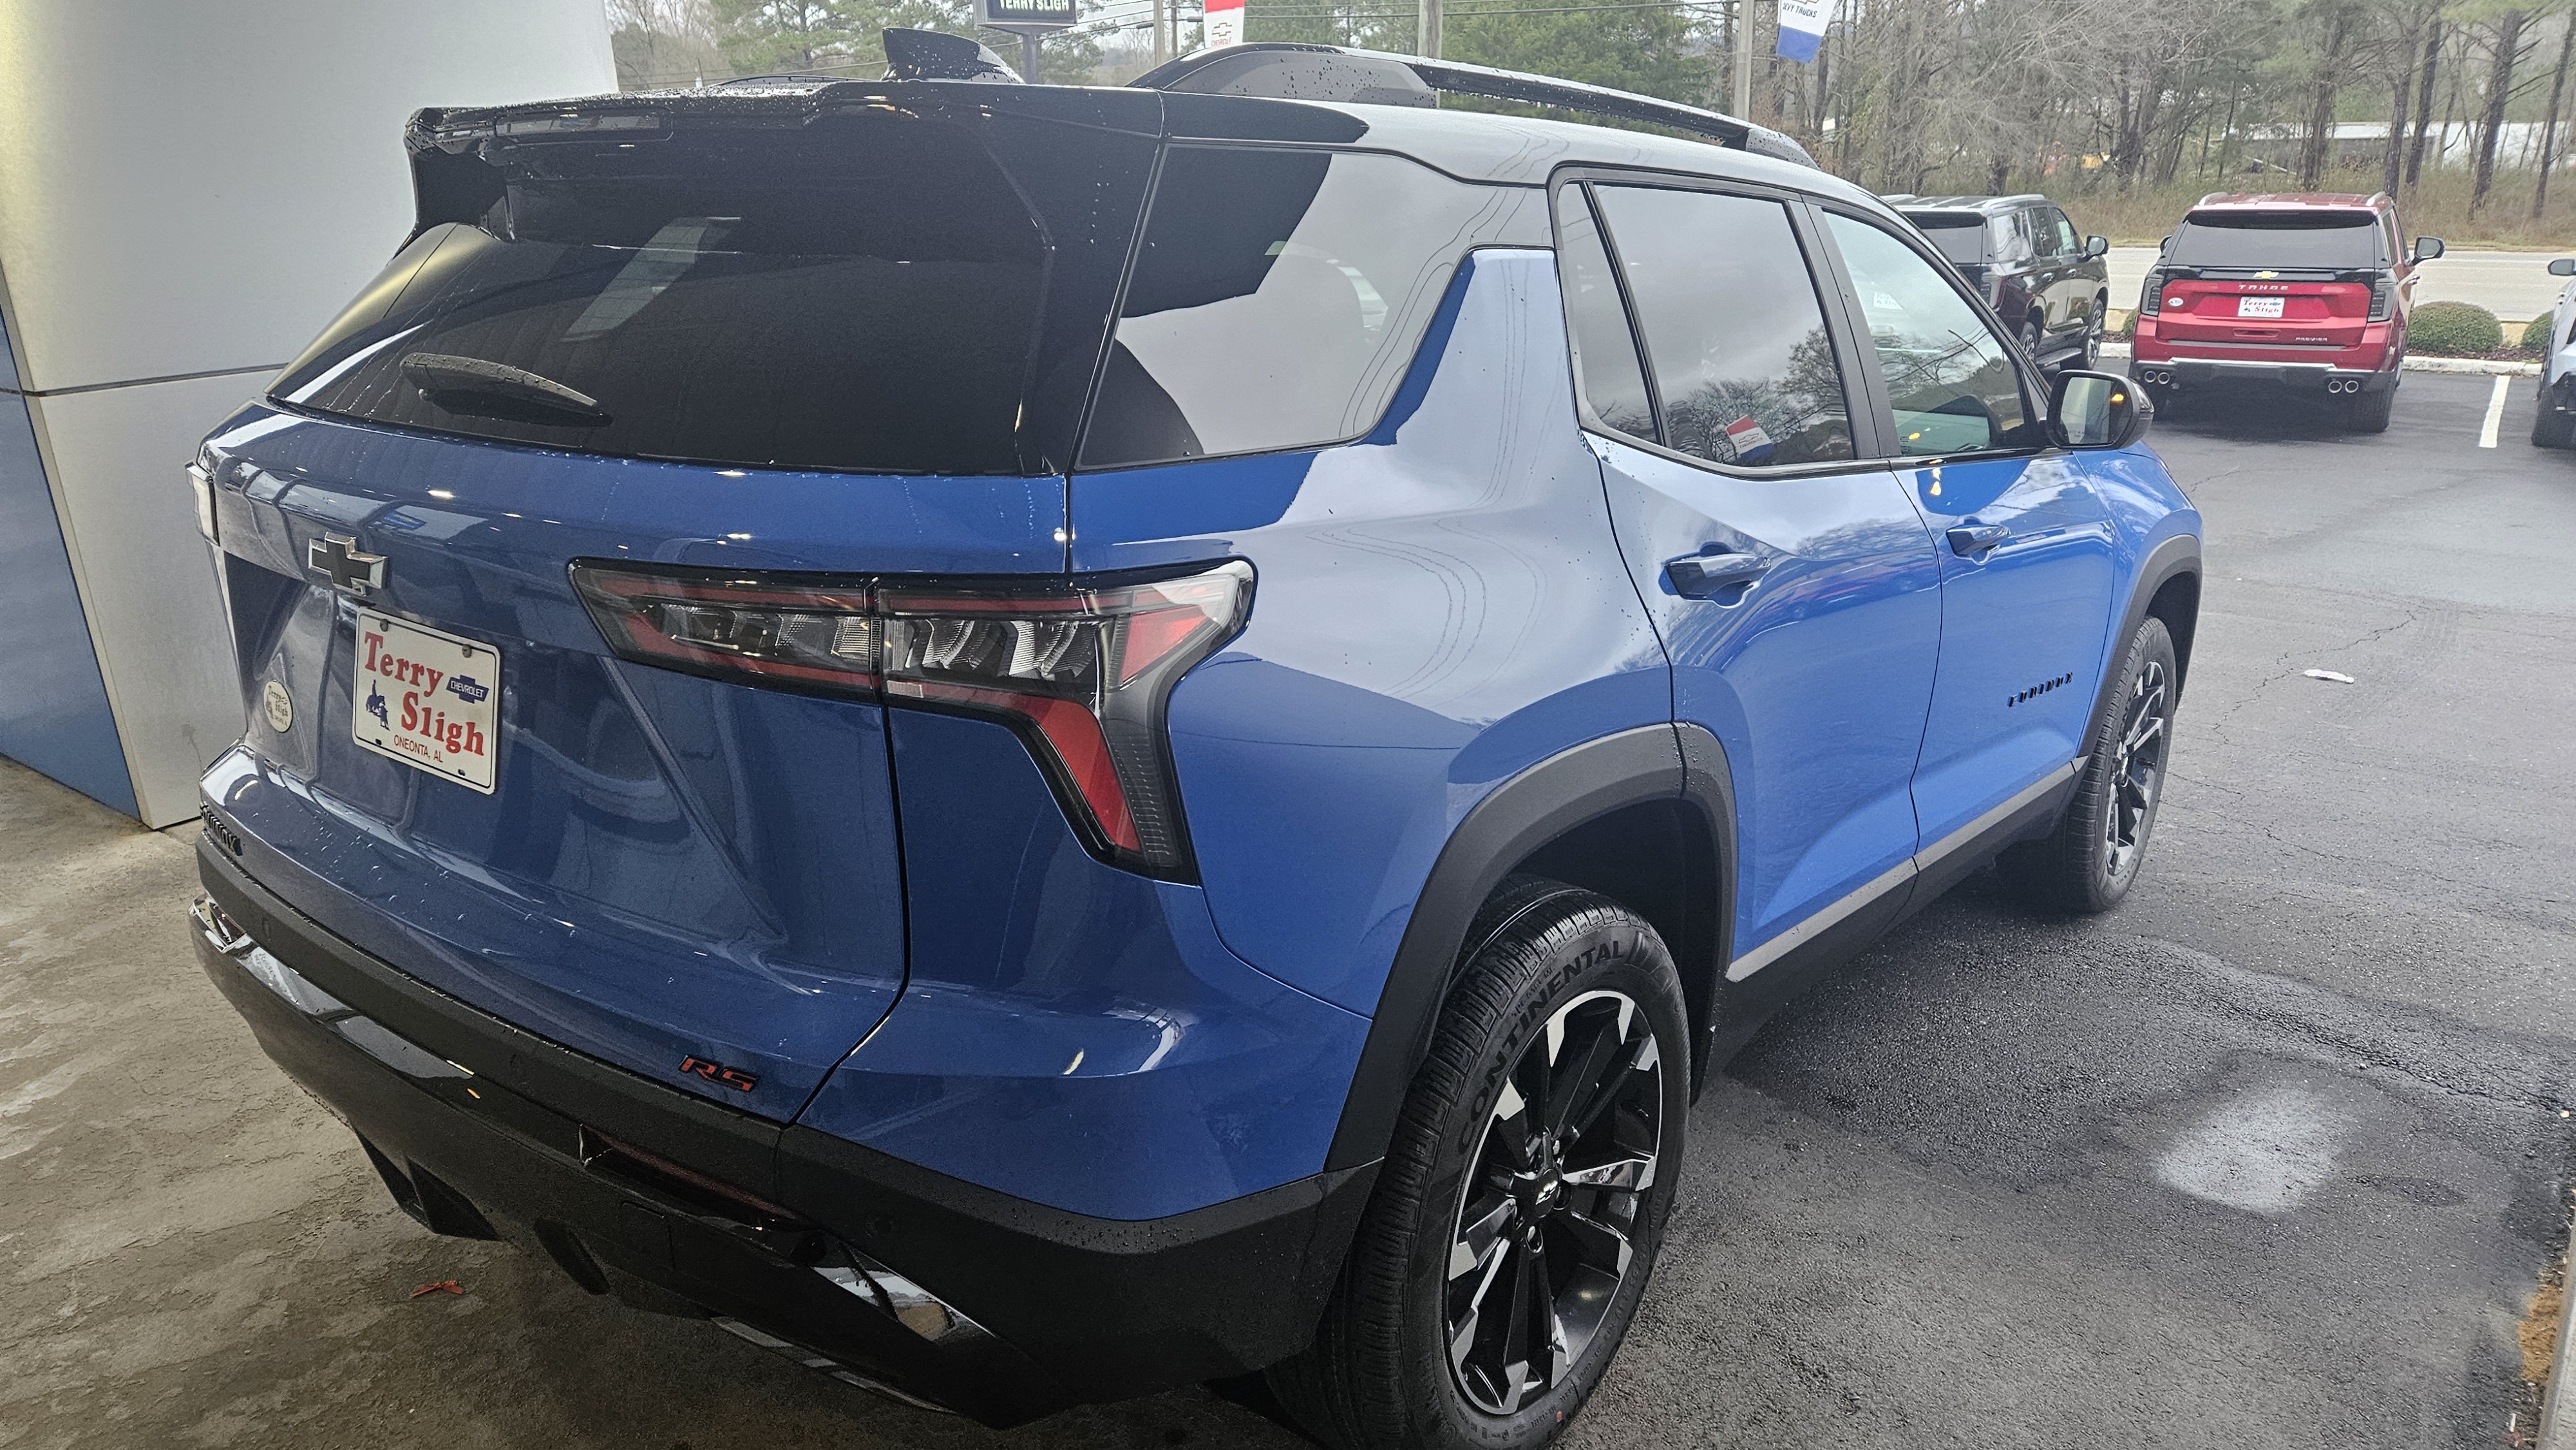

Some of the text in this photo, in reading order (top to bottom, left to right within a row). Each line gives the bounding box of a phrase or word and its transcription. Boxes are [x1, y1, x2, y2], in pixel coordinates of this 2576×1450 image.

[999, 0, 1070, 11] TERRY SLIGH
[1795, 6, 1817, 18] TRUCKS
[365, 631, 444, 697] Terry
[450, 680, 484, 698] CHEVROLET
[401, 691, 484, 756] Sligh
[393, 735, 444, 763] ONEONTA, AL
[1457, 940, 1624, 1154] CONTINENTAL
[679, 1055, 761, 1093] RS
